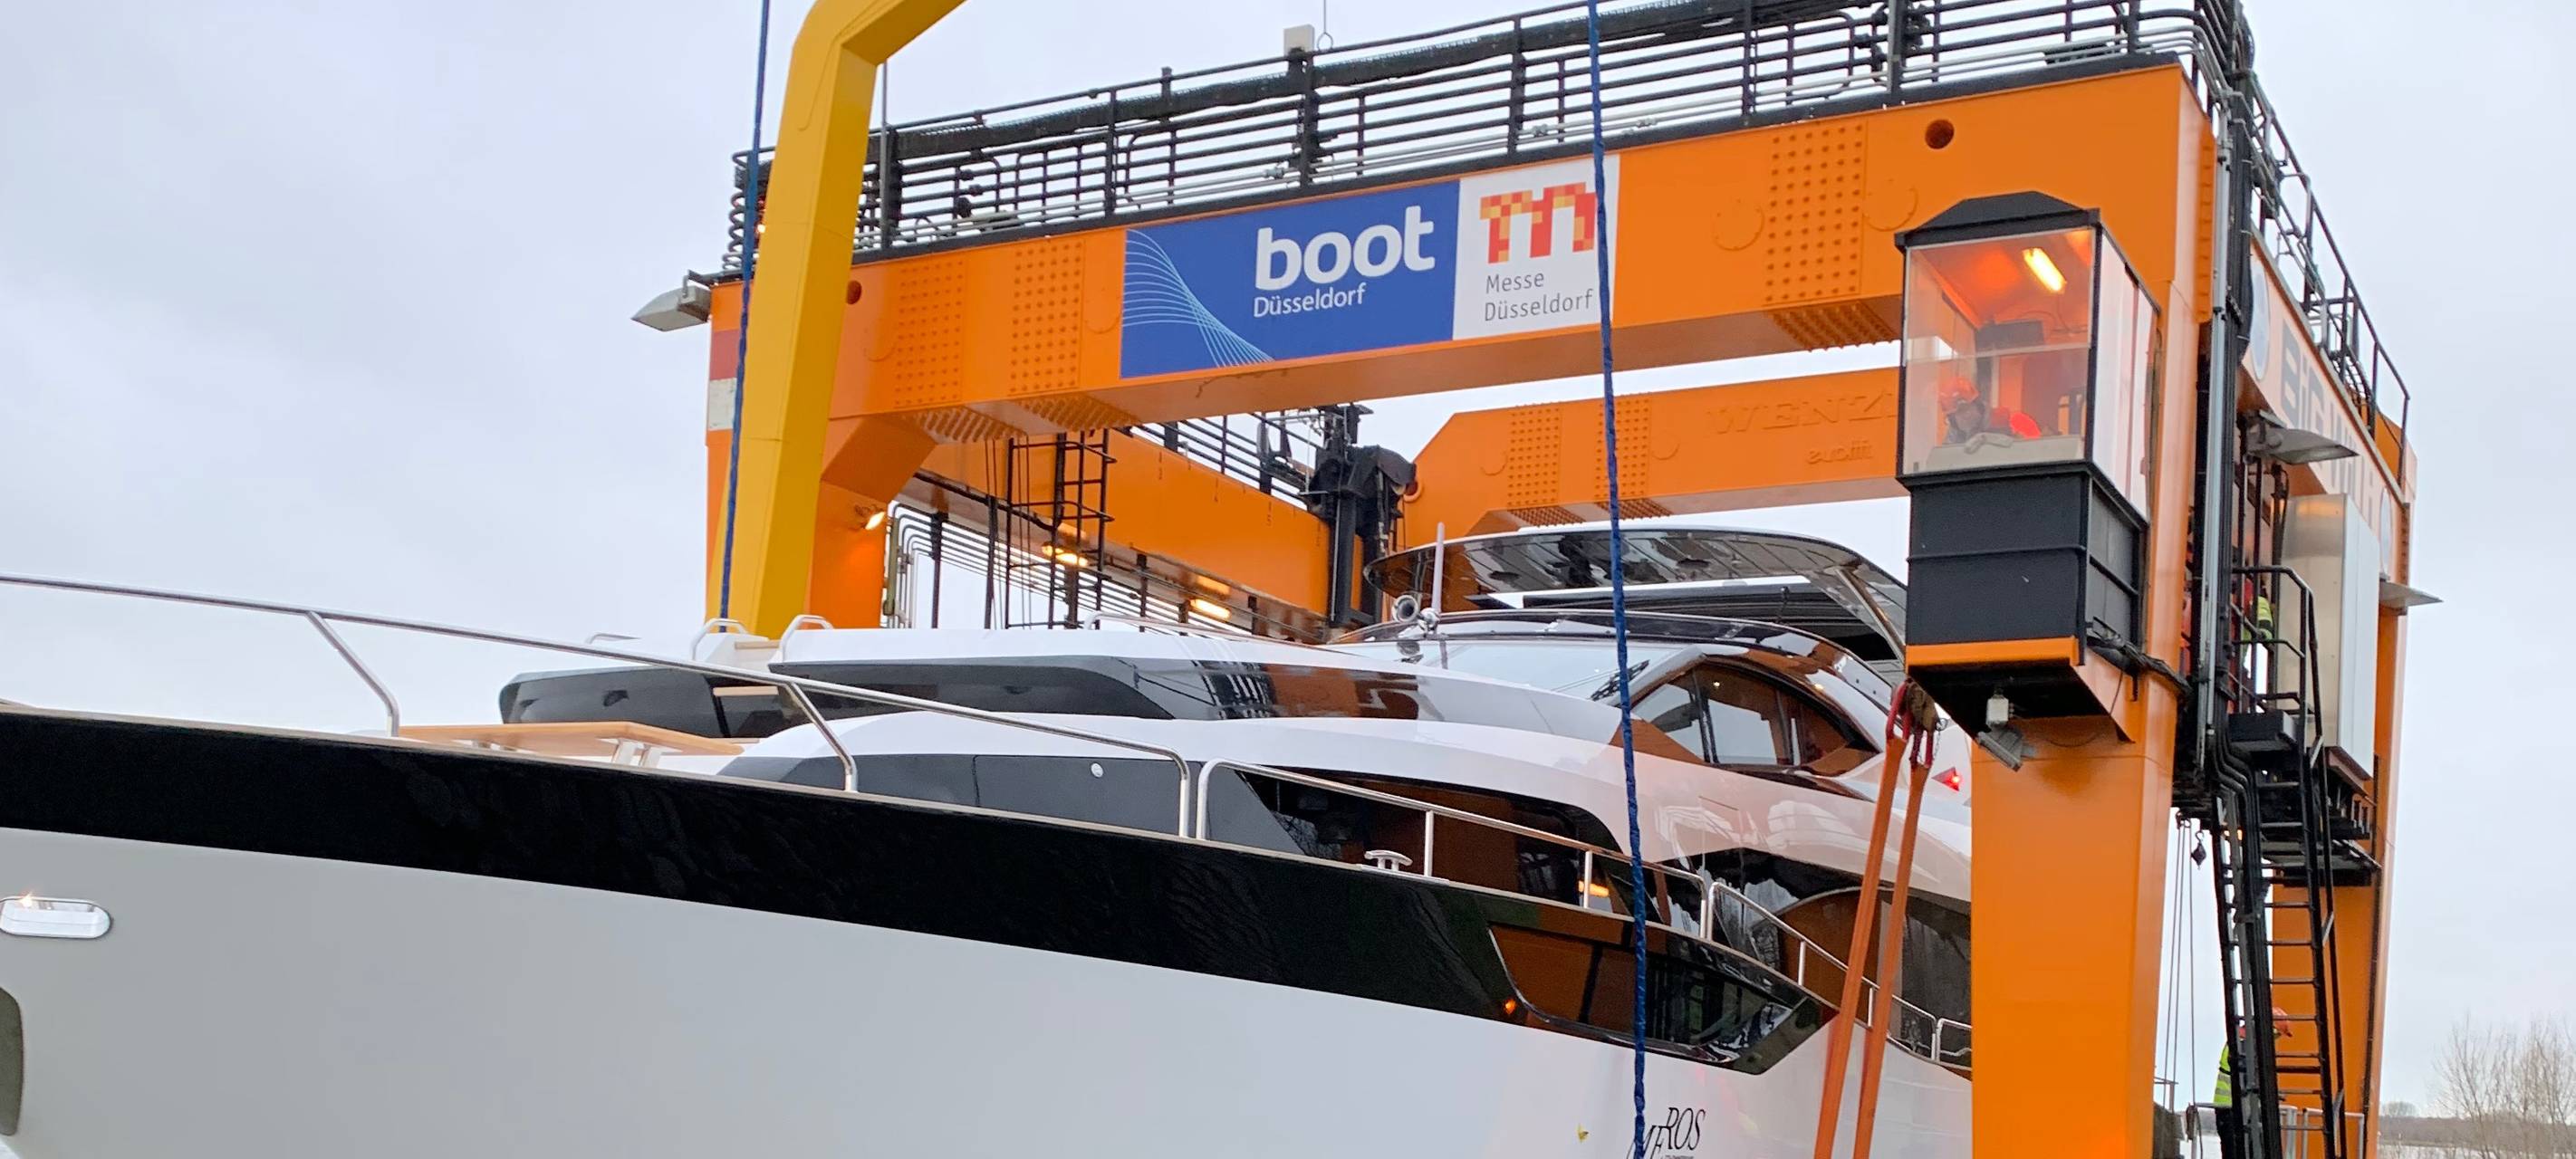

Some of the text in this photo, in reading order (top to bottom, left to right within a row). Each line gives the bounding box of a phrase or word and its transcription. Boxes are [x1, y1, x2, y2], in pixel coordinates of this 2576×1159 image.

[1255, 206, 1436, 290] boot
[1486, 273, 1544, 293] Messe
[1254, 283, 1366, 317] Düsseldorf
[1485, 289, 1594, 321] Düsseldorf
